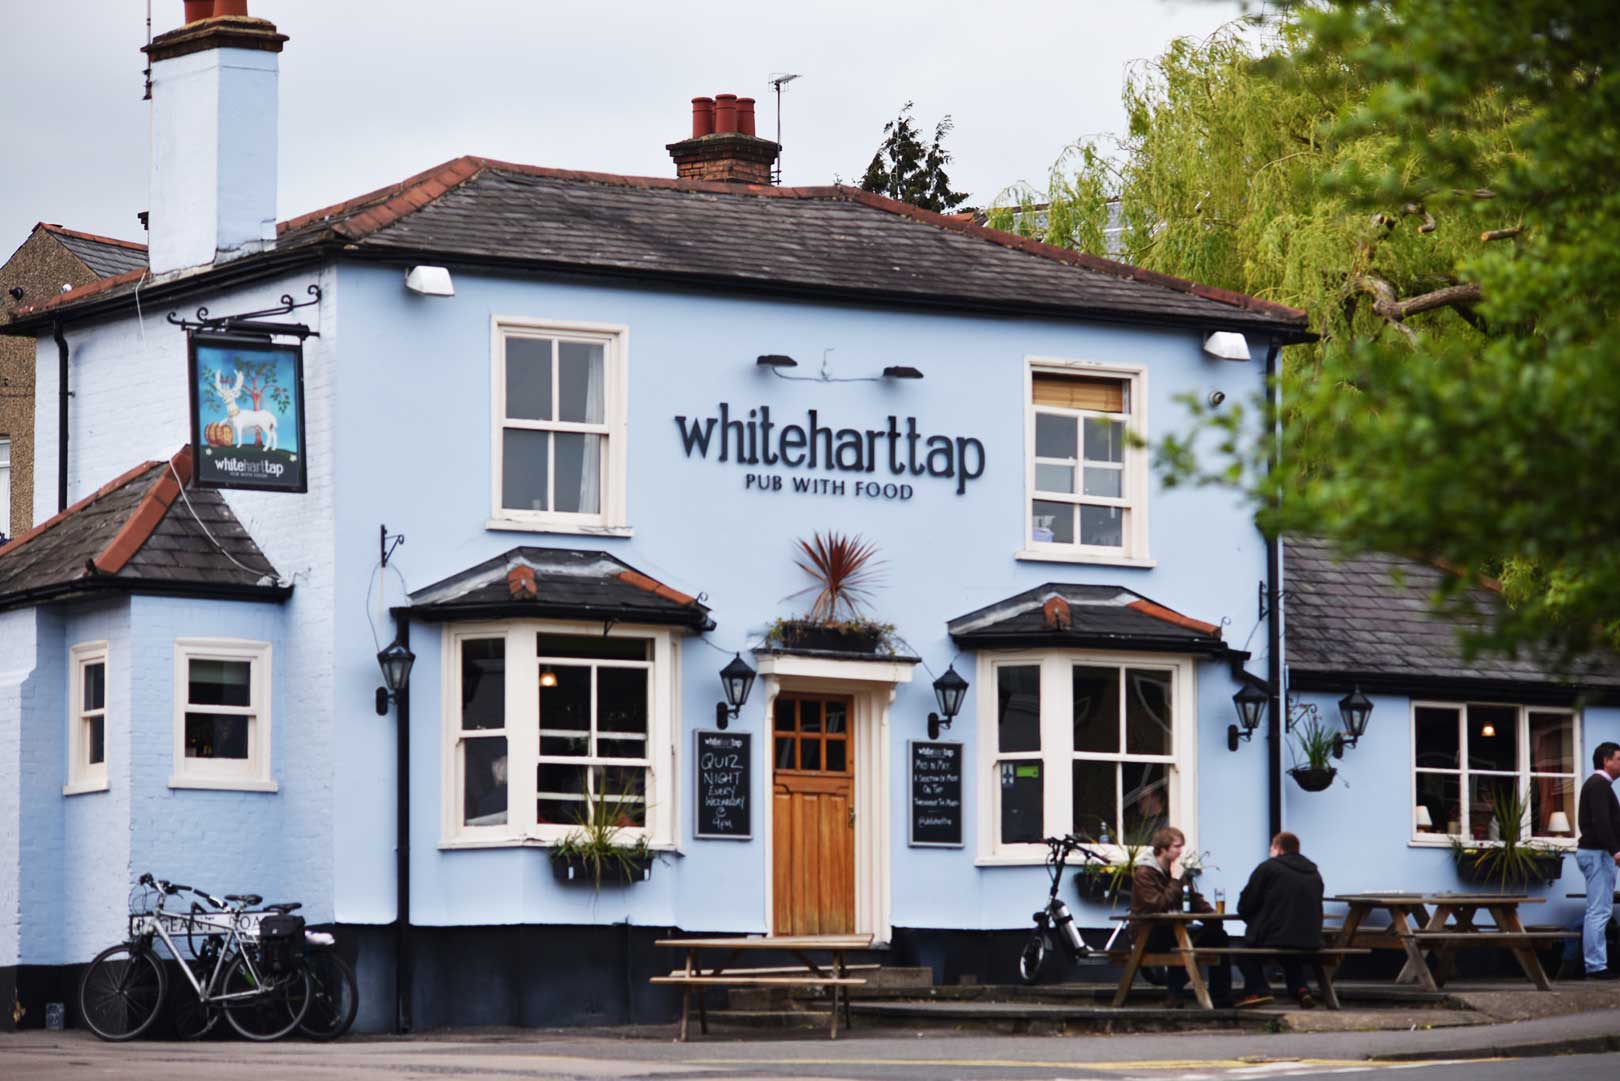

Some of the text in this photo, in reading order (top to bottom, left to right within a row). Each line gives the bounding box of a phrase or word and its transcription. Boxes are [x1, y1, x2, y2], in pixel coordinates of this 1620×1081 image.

[674, 402, 986, 495] whiteharttap
[215, 457, 284, 477] whiteharttap
[746, 474, 914, 500] PUB WITH FOOD
[701, 752, 744, 770] QUIZ
[704, 770, 743, 785] NIGHT
